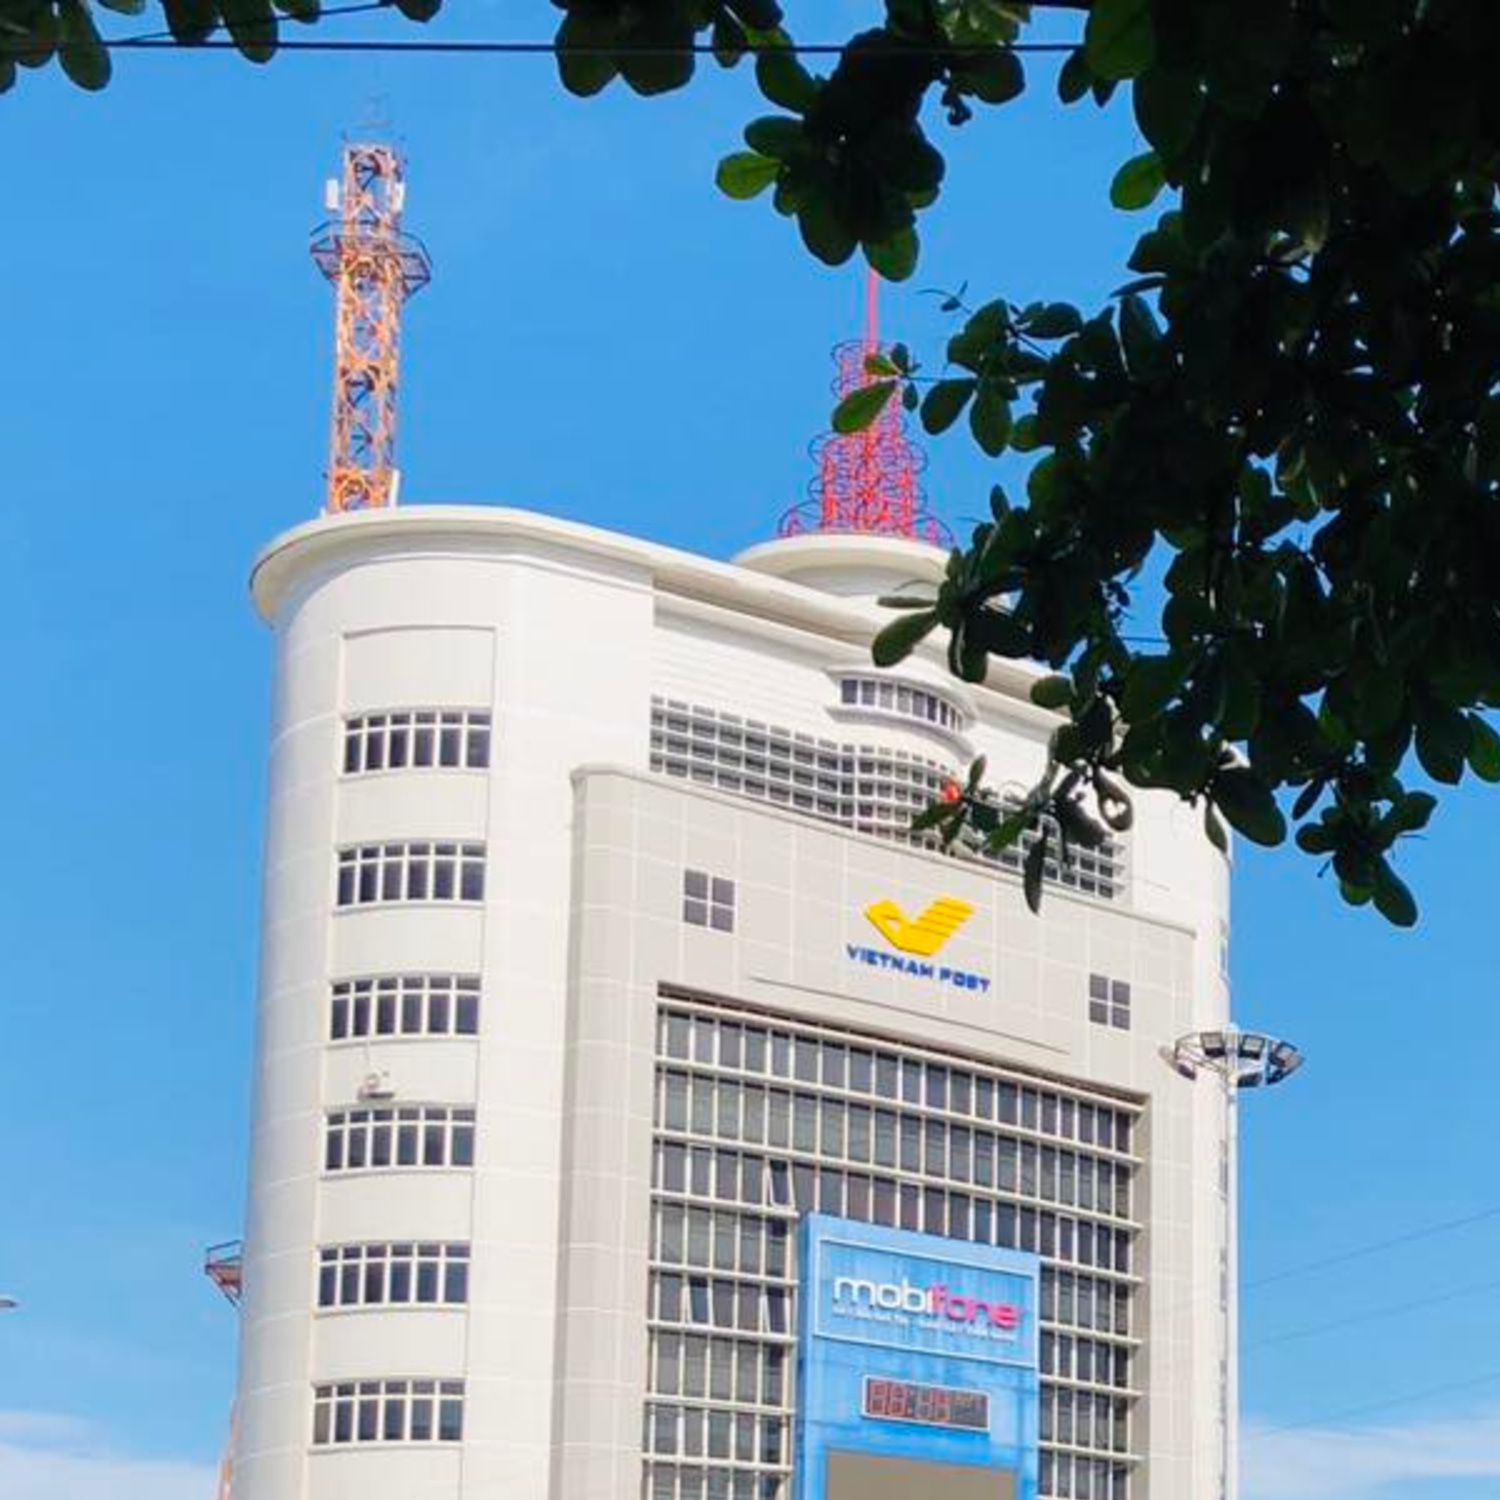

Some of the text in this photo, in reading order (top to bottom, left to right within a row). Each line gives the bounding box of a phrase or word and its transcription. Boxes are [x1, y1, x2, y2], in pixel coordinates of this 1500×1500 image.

[846, 943, 991, 992] VIETNAM POST
[833, 1276, 1019, 1330] mobifone
